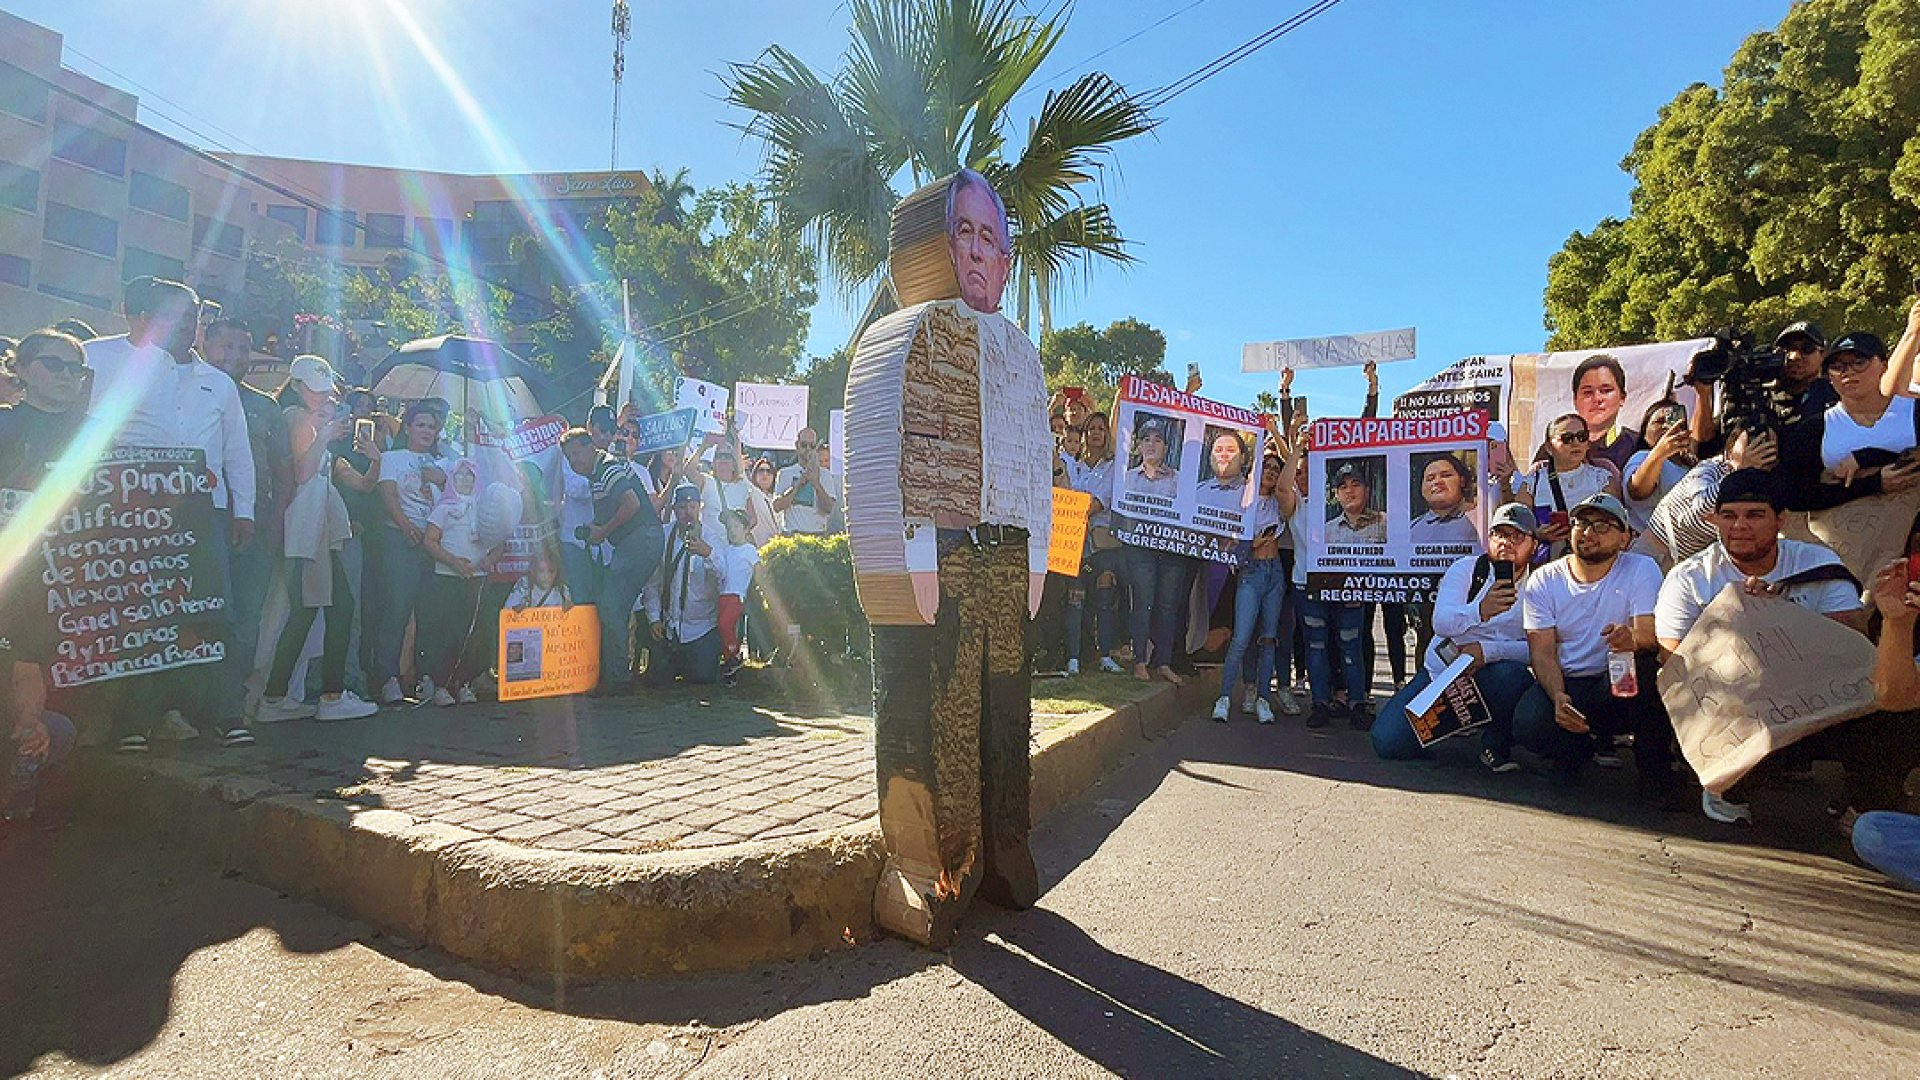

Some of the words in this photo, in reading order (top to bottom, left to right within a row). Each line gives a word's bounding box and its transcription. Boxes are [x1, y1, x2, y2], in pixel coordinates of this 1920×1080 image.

[1128, 376, 1261, 424] DESAPARECIDOS
[1409, 397, 1425, 407] NO
[1428, 393, 1451, 406] MÁS
[1453, 390, 1491, 404] NIÑOS
[1315, 412, 1480, 447] DESAPARECIDOS
[1117, 528, 1185, 555] REGRESAR
[1188, 546, 1198, 557] A
[1201, 548, 1238, 566] CASA
[1135, 523, 1206, 546] AYÚDALOS
[1209, 537, 1219, 549] A
[81, 559, 126, 583] 100
[1343, 574, 1432, 589] AYÚDALOS
[47, 573, 176, 614] Alexander
[1320, 589, 1407, 603] REGRESAR
[1412, 589, 1424, 602] A
[58, 607, 119, 636] Gael
[96, 635, 118, 656] 12
